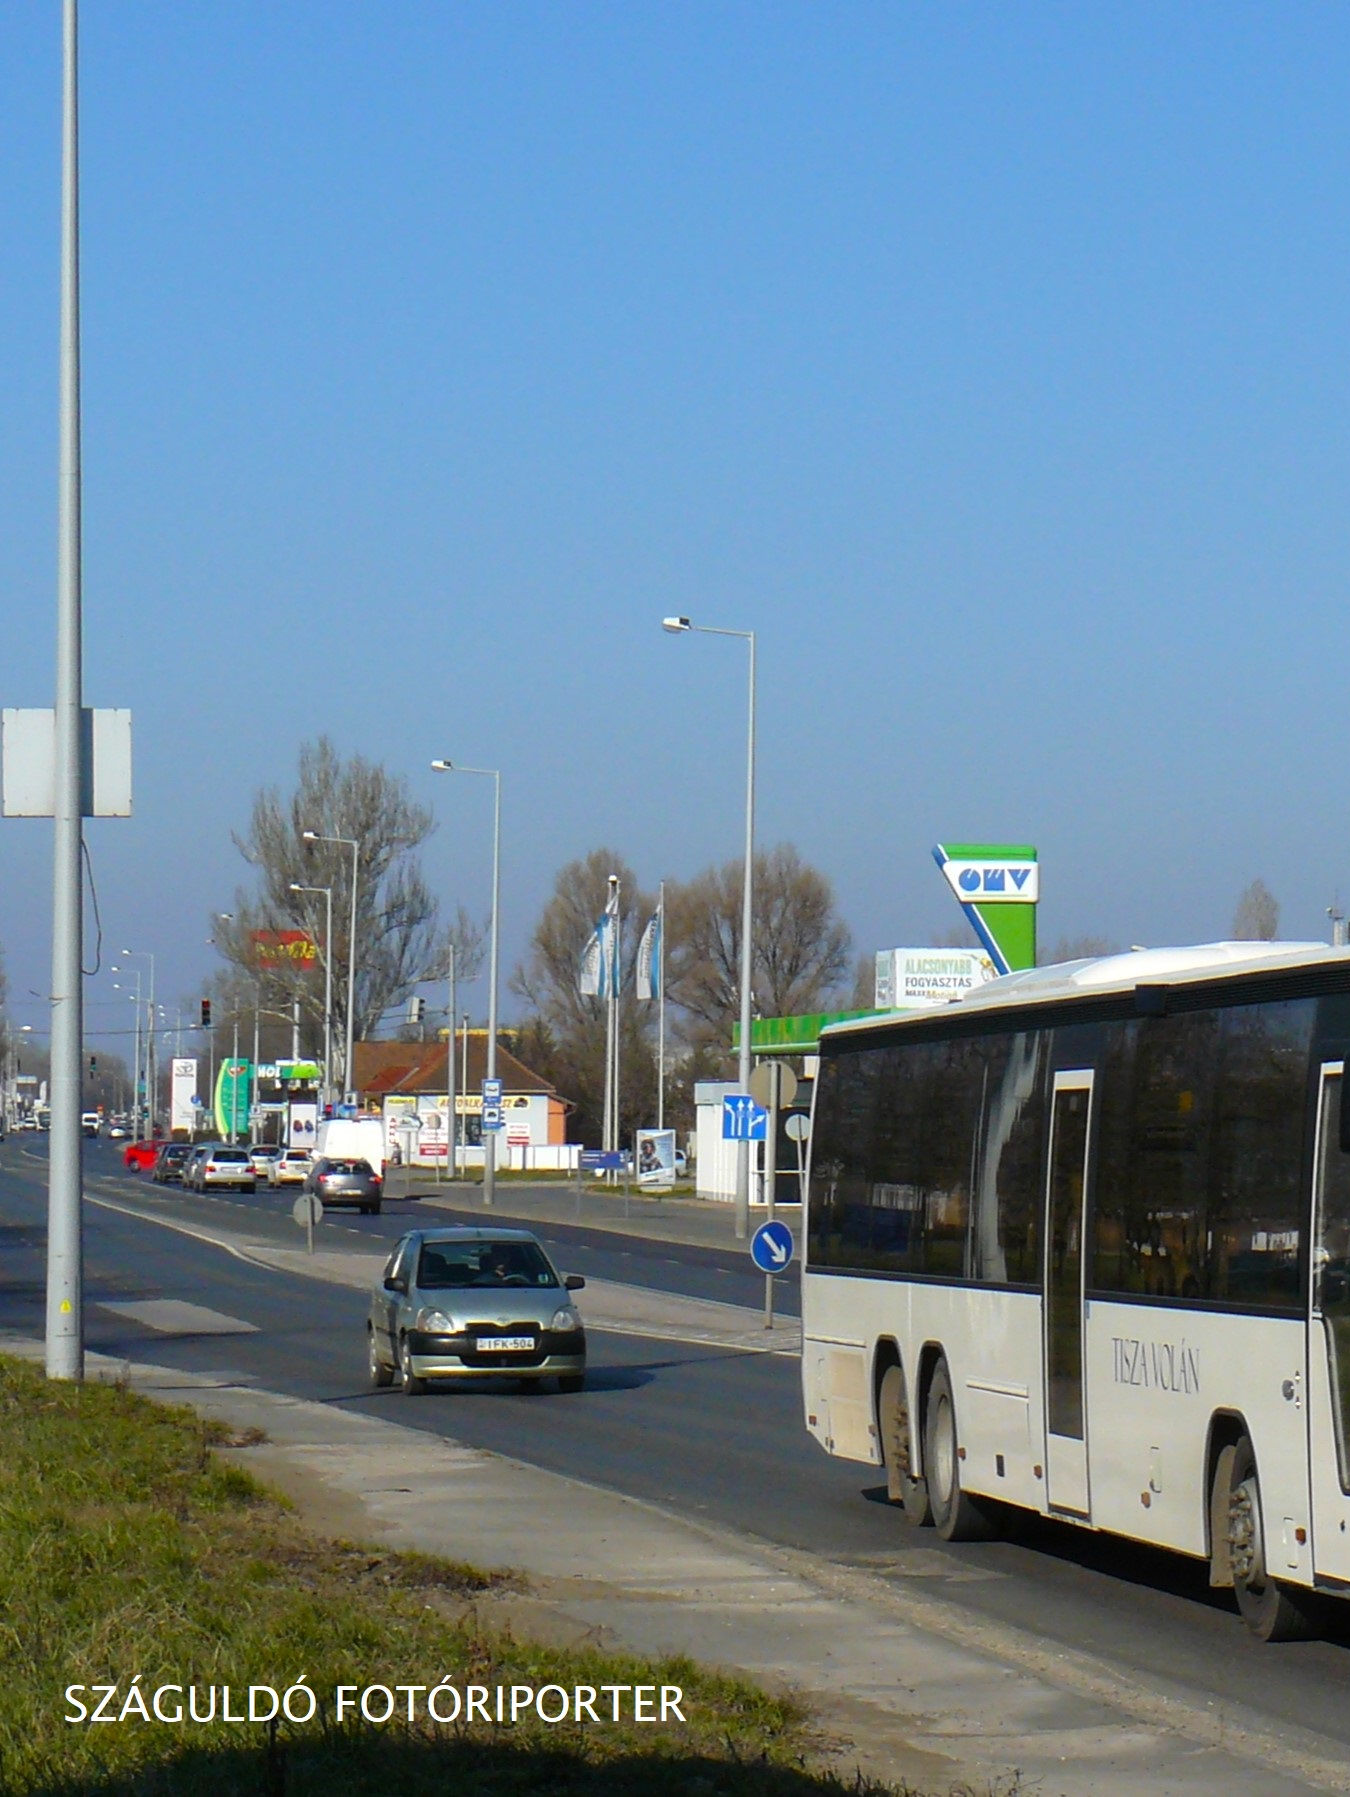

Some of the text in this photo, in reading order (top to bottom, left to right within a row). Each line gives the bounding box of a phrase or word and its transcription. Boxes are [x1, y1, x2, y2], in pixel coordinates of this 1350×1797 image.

[959, 868, 1031, 891] OMV
[905, 959, 971, 975] ALACSONYABB
[1111, 1337, 1200, 1394] TISZA VOLÁN
